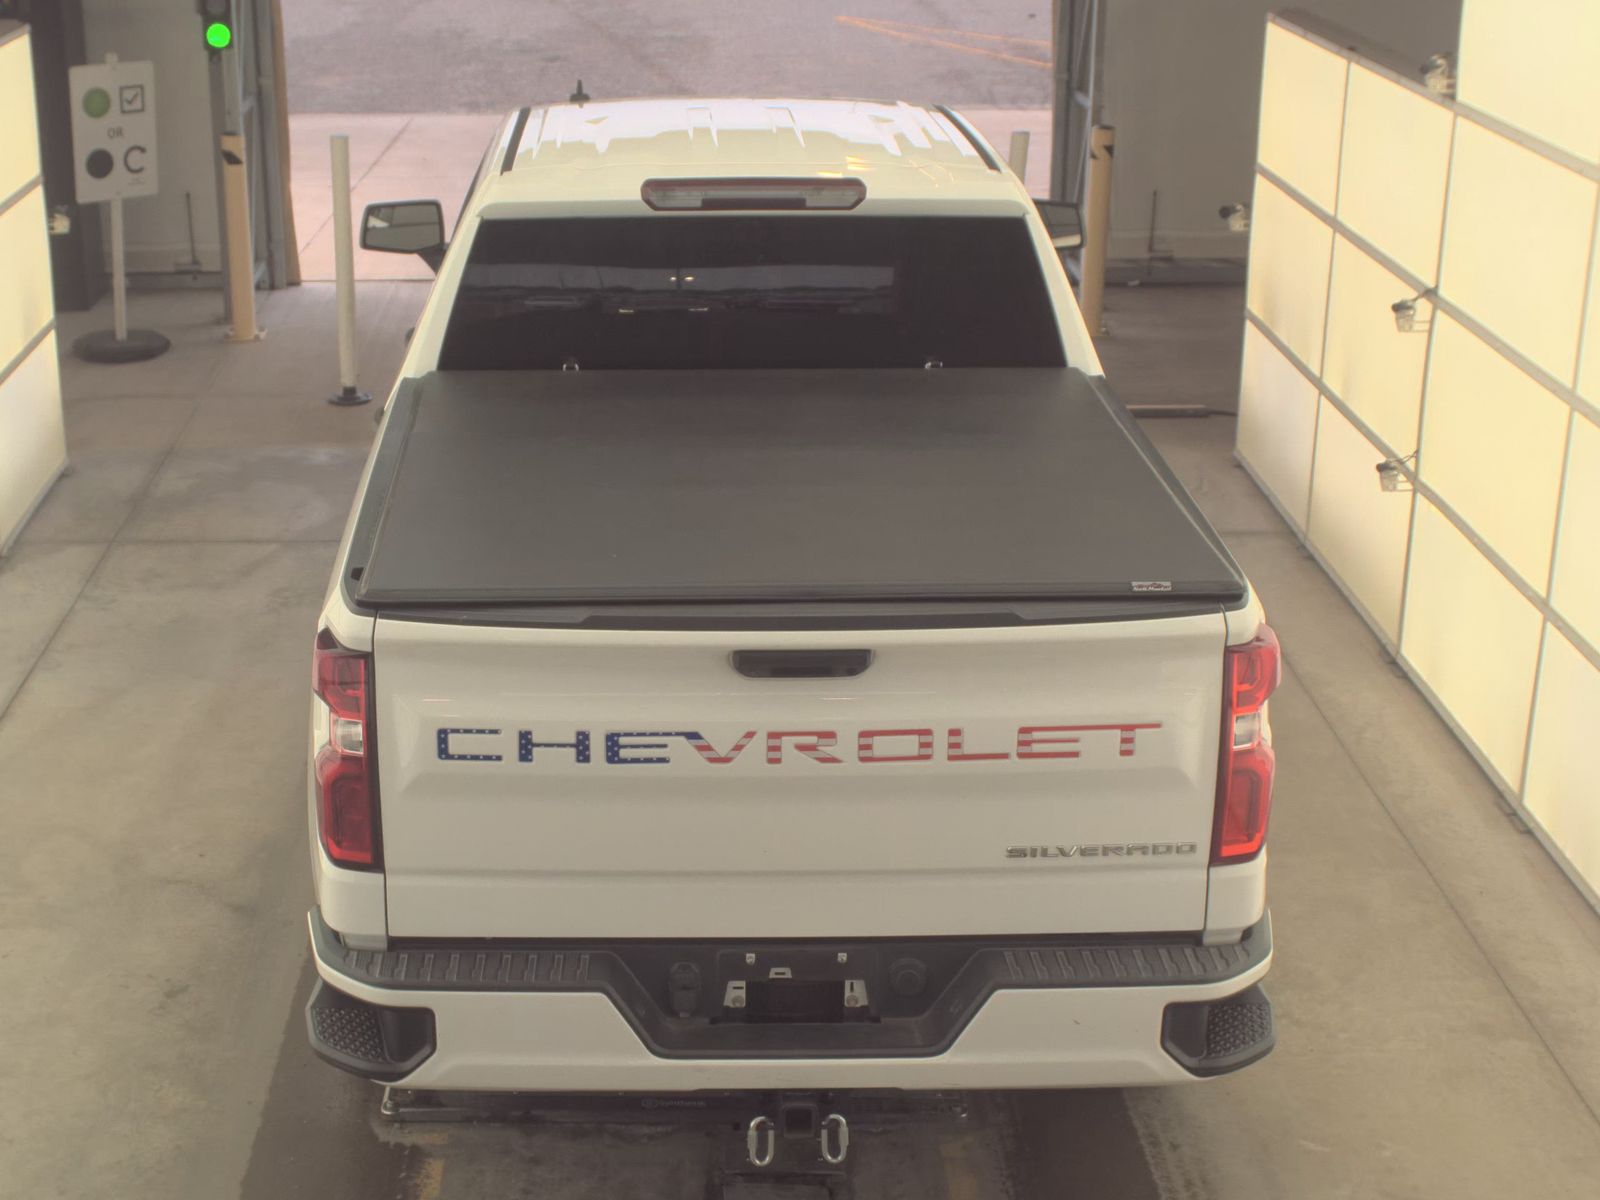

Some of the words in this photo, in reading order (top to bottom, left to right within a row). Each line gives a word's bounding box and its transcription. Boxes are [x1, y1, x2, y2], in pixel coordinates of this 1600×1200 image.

[107, 126, 124, 139] OR
[437, 722, 1163, 764] CHEVROLET
[1006, 842, 1197, 859] SILVERADO
